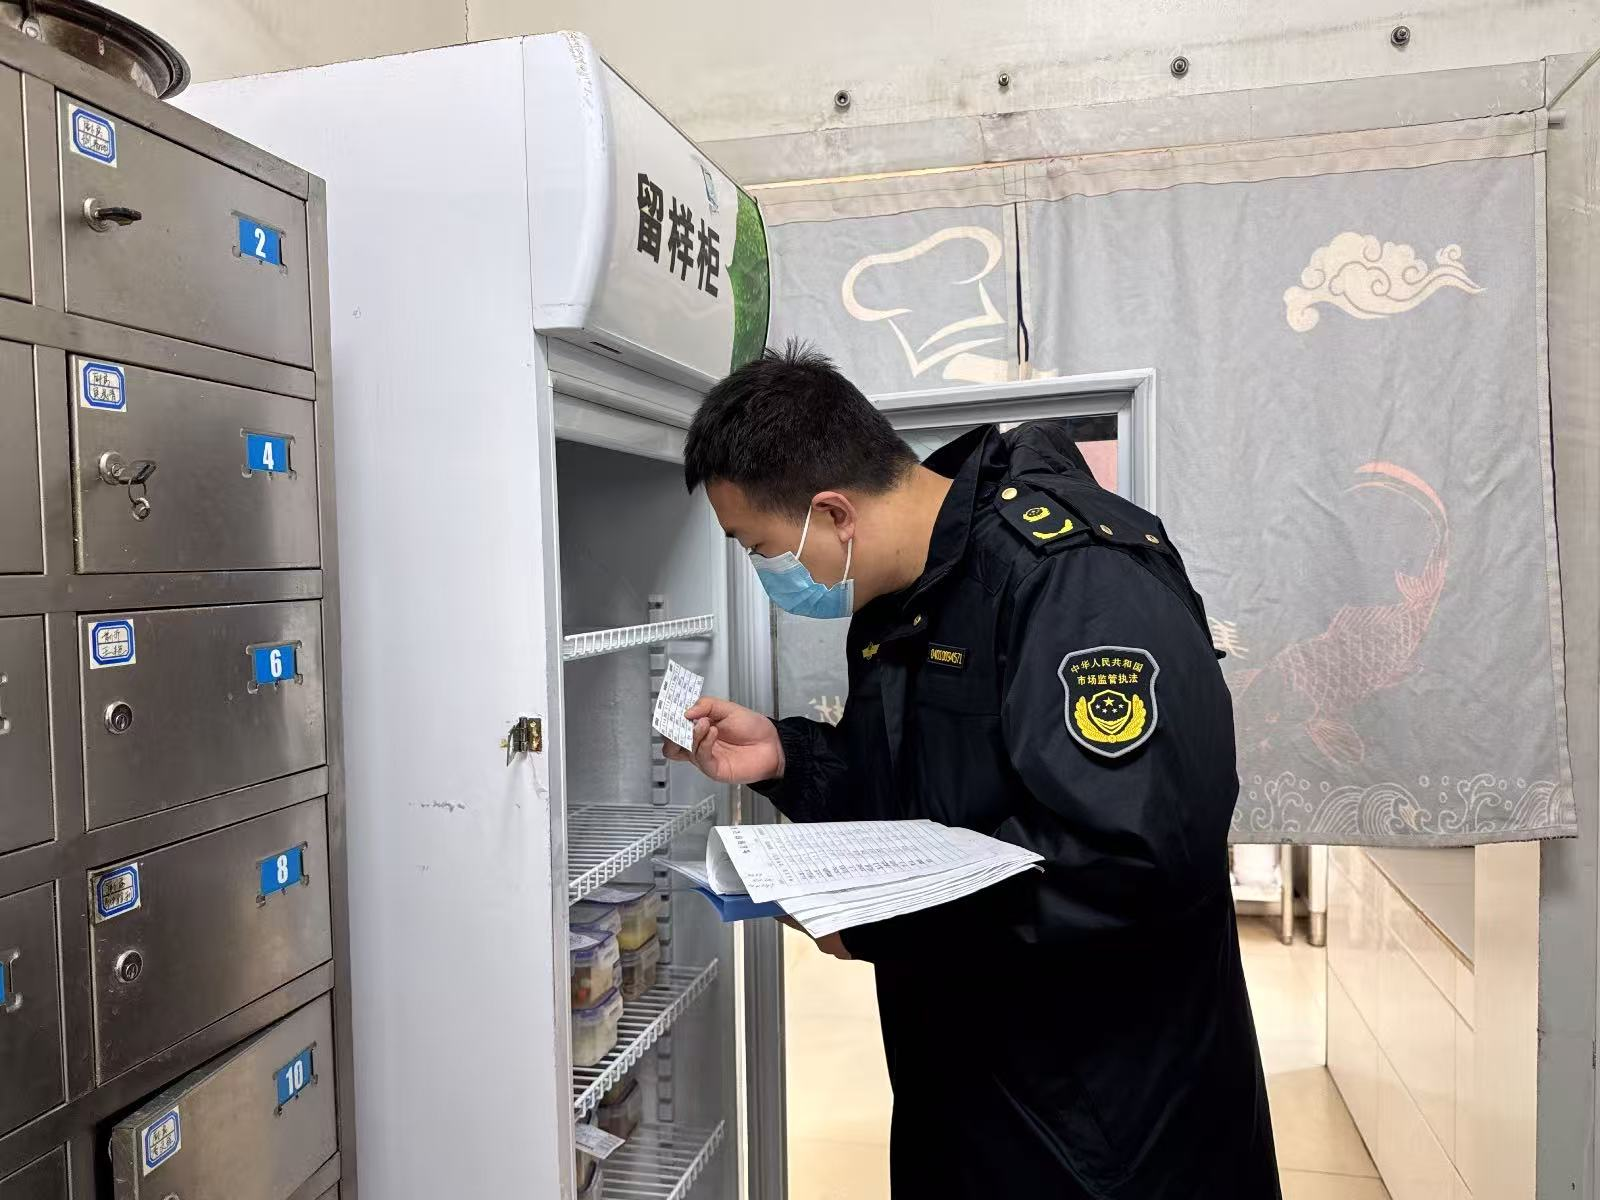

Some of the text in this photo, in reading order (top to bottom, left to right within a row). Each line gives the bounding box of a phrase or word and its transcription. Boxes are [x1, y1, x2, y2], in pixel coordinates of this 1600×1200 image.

[254, 227, 266, 258] 2
[637, 172, 720, 298] 留样柜
[262, 441, 275, 470] 4
[269, 648, 283, 678] 6
[1070, 657, 1144, 674] 中华人民共和国
[1076, 672, 1139, 686] 市场监管执法
[276, 854, 289, 884] 8
[284, 1059, 304, 1096] 10
